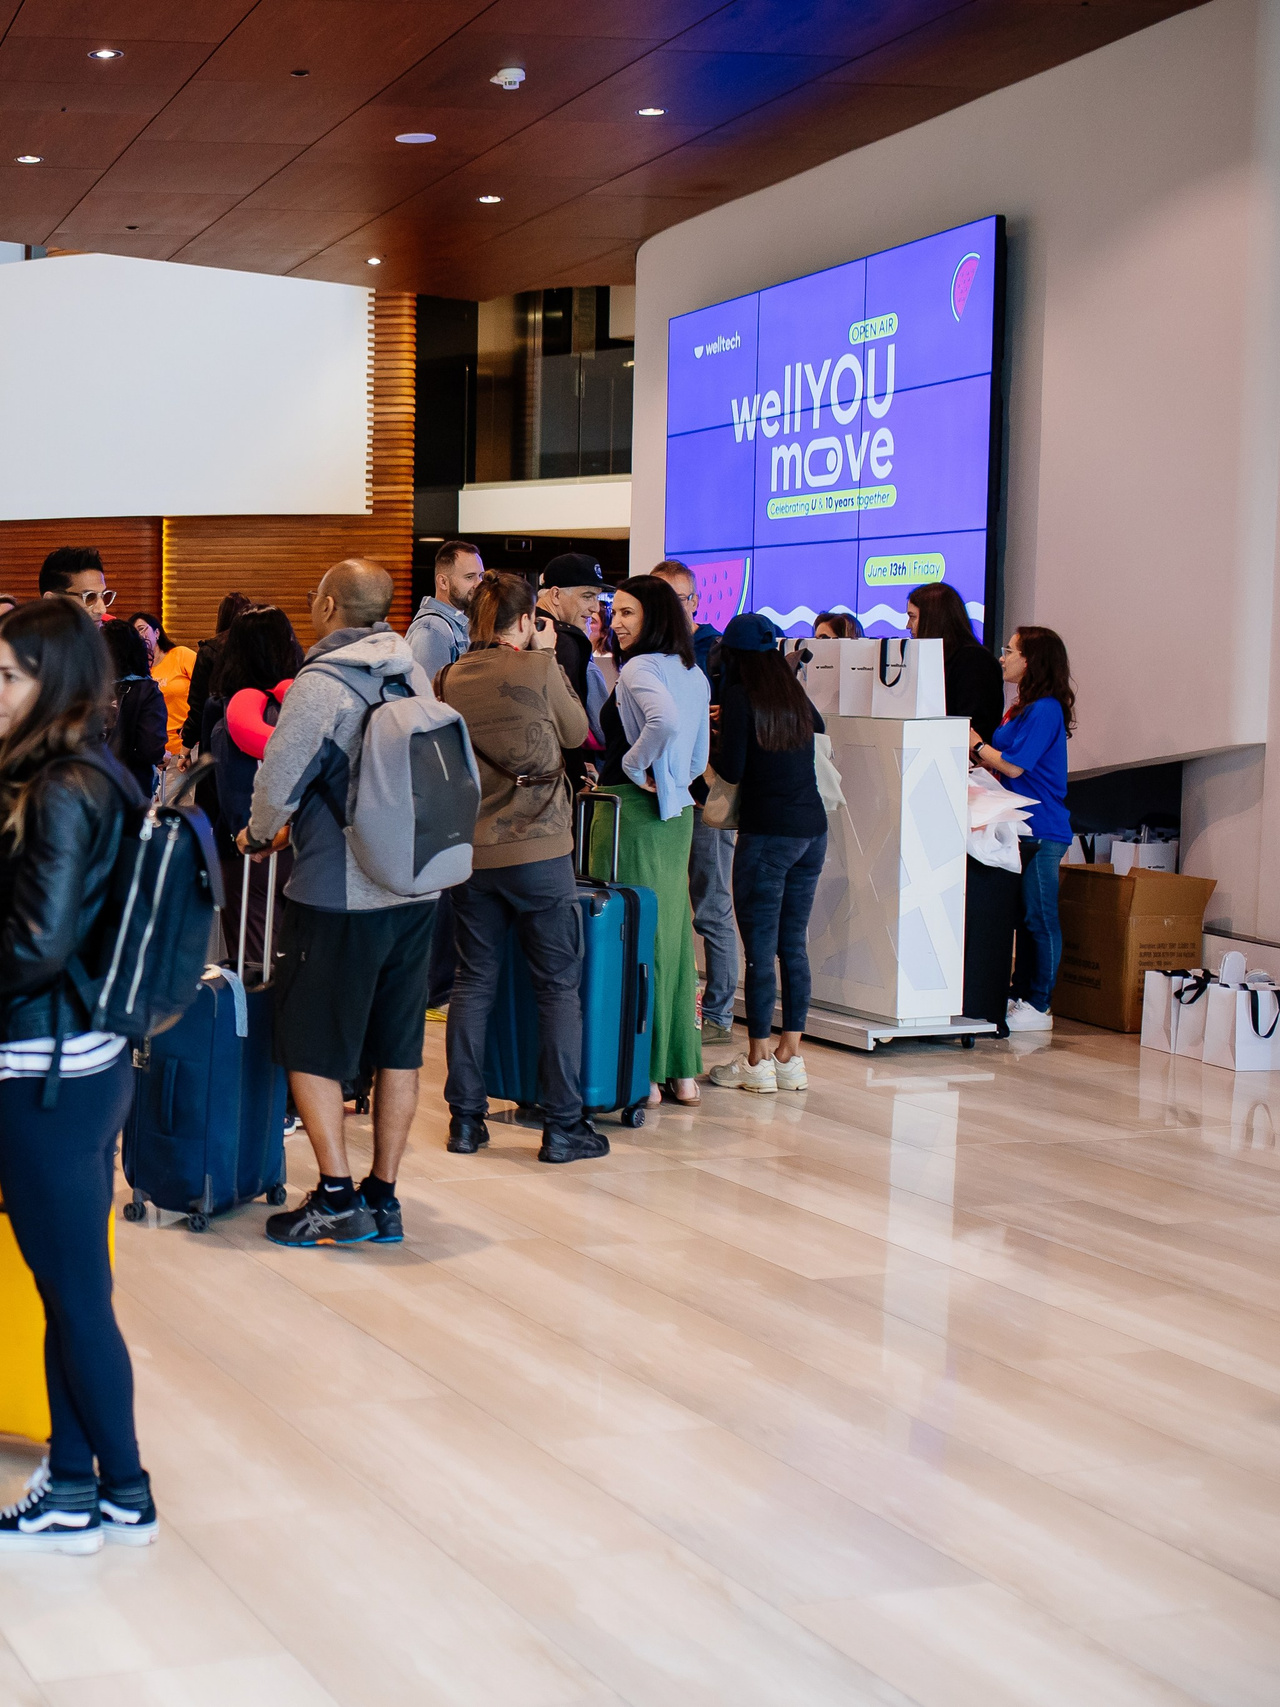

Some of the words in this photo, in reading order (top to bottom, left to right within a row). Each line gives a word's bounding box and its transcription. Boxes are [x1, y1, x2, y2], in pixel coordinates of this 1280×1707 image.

[851, 322, 877, 341] OPEN
[879, 317, 894, 336] AIR
[705, 331, 741, 356] welltech
[731, 343, 896, 443] wellYOU
[771, 427, 895, 492] move
[770, 500, 810, 515] Celebrating
[811, 499, 817, 511] U
[825, 497, 833, 509] 10
[834, 497, 854, 511] years
[856, 492, 890, 509] together
[868, 563, 887, 577] June
[890, 562, 907, 576] 13th
[913, 561, 941, 576] Friday
